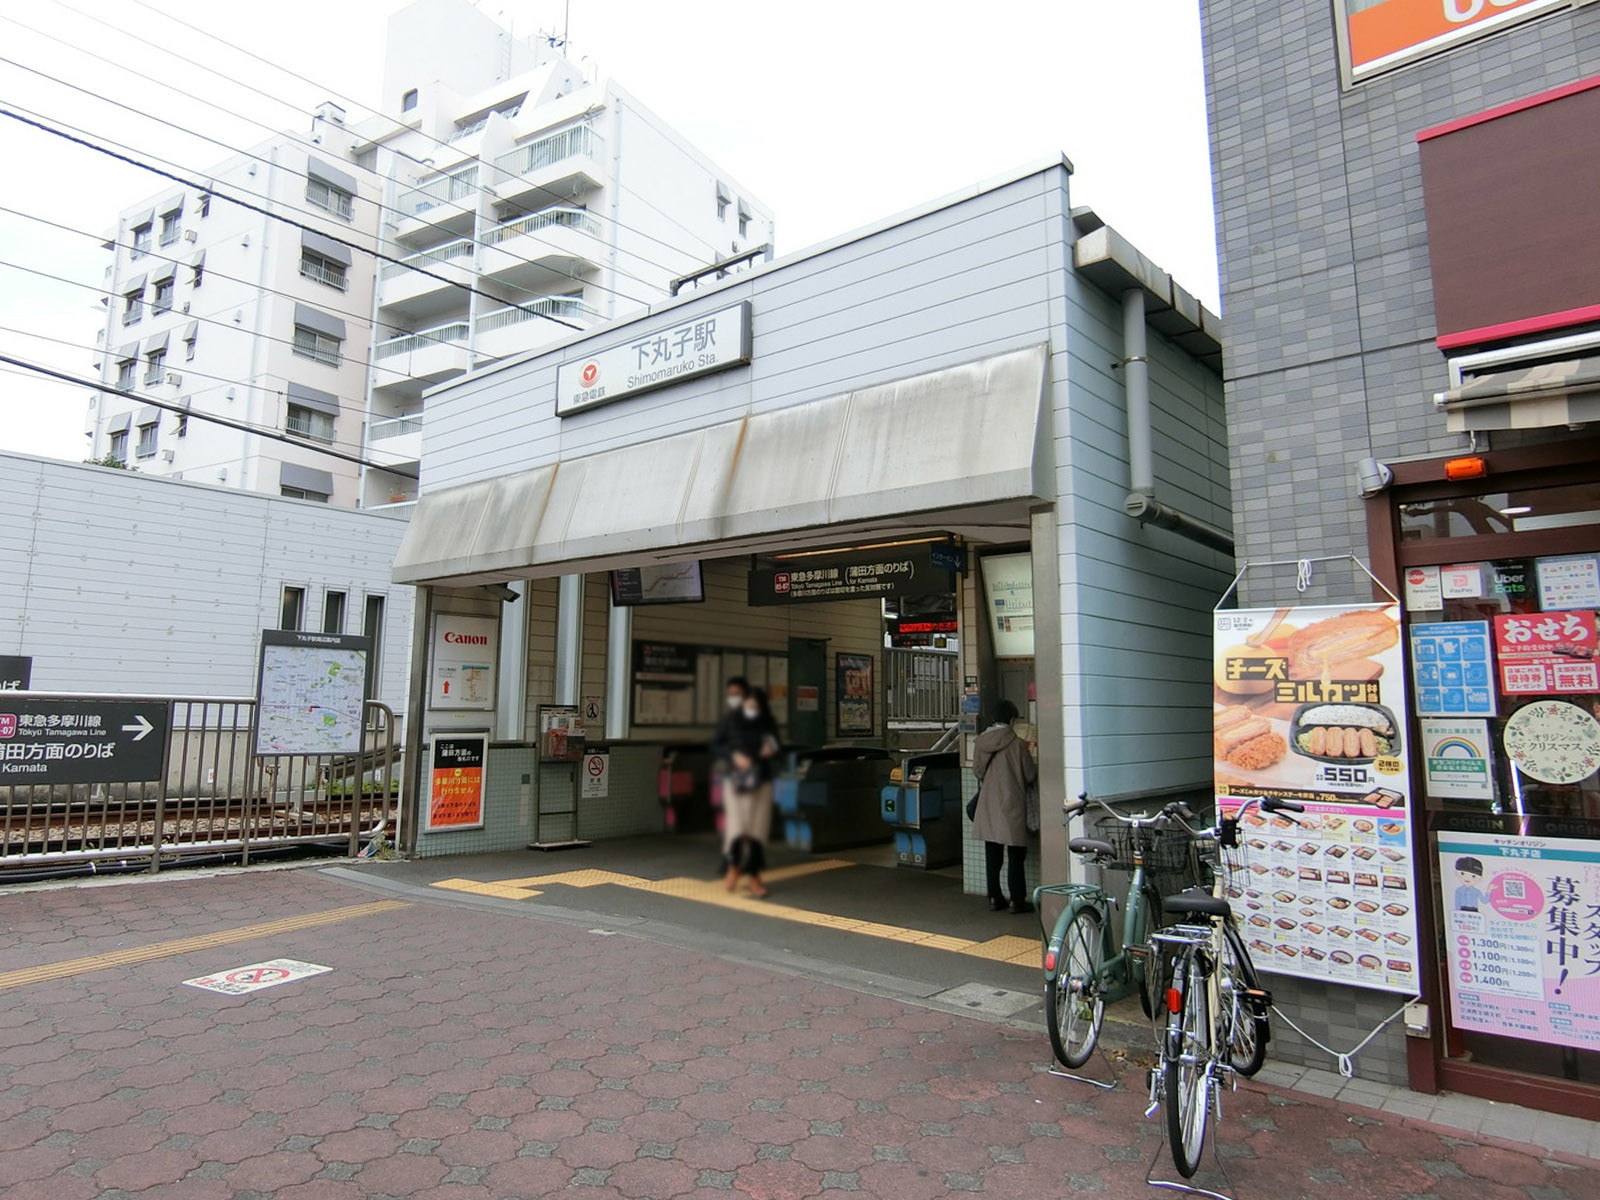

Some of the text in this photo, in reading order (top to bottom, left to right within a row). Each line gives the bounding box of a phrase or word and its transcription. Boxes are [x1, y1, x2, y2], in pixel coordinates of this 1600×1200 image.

[631, 318, 717, 370] 下丸子駅
[627, 353, 719, 390] Shimomaruko Sta.
[573, 386, 606, 405] 東急電鉄
[790, 568, 839, 582] 東急多摩川線
[1494, 574, 1525, 584] Uber
[1494, 584, 1526, 594] Eats
[1503, 614, 1589, 644] おせち
[443, 631, 488, 646] Canon
[1227, 658, 1287, 680] チーズ
[1559, 674, 1593, 687] 無料
[18, 714, 102, 728] 東急多摩川線
[45, 728, 88, 738] Tamagawa
[90, 729, 107, 737] Line
[1529, 741, 1583, 752] クリスマス
[2, 762, 48, 773] Kamata
[1449, 817, 1504, 830] ORIGIN
[1493, 838, 1547, 848] キッチンオリジン
[1498, 846, 1542, 859] 下丸子店
[1545, 876, 1581, 995] 募集中!
